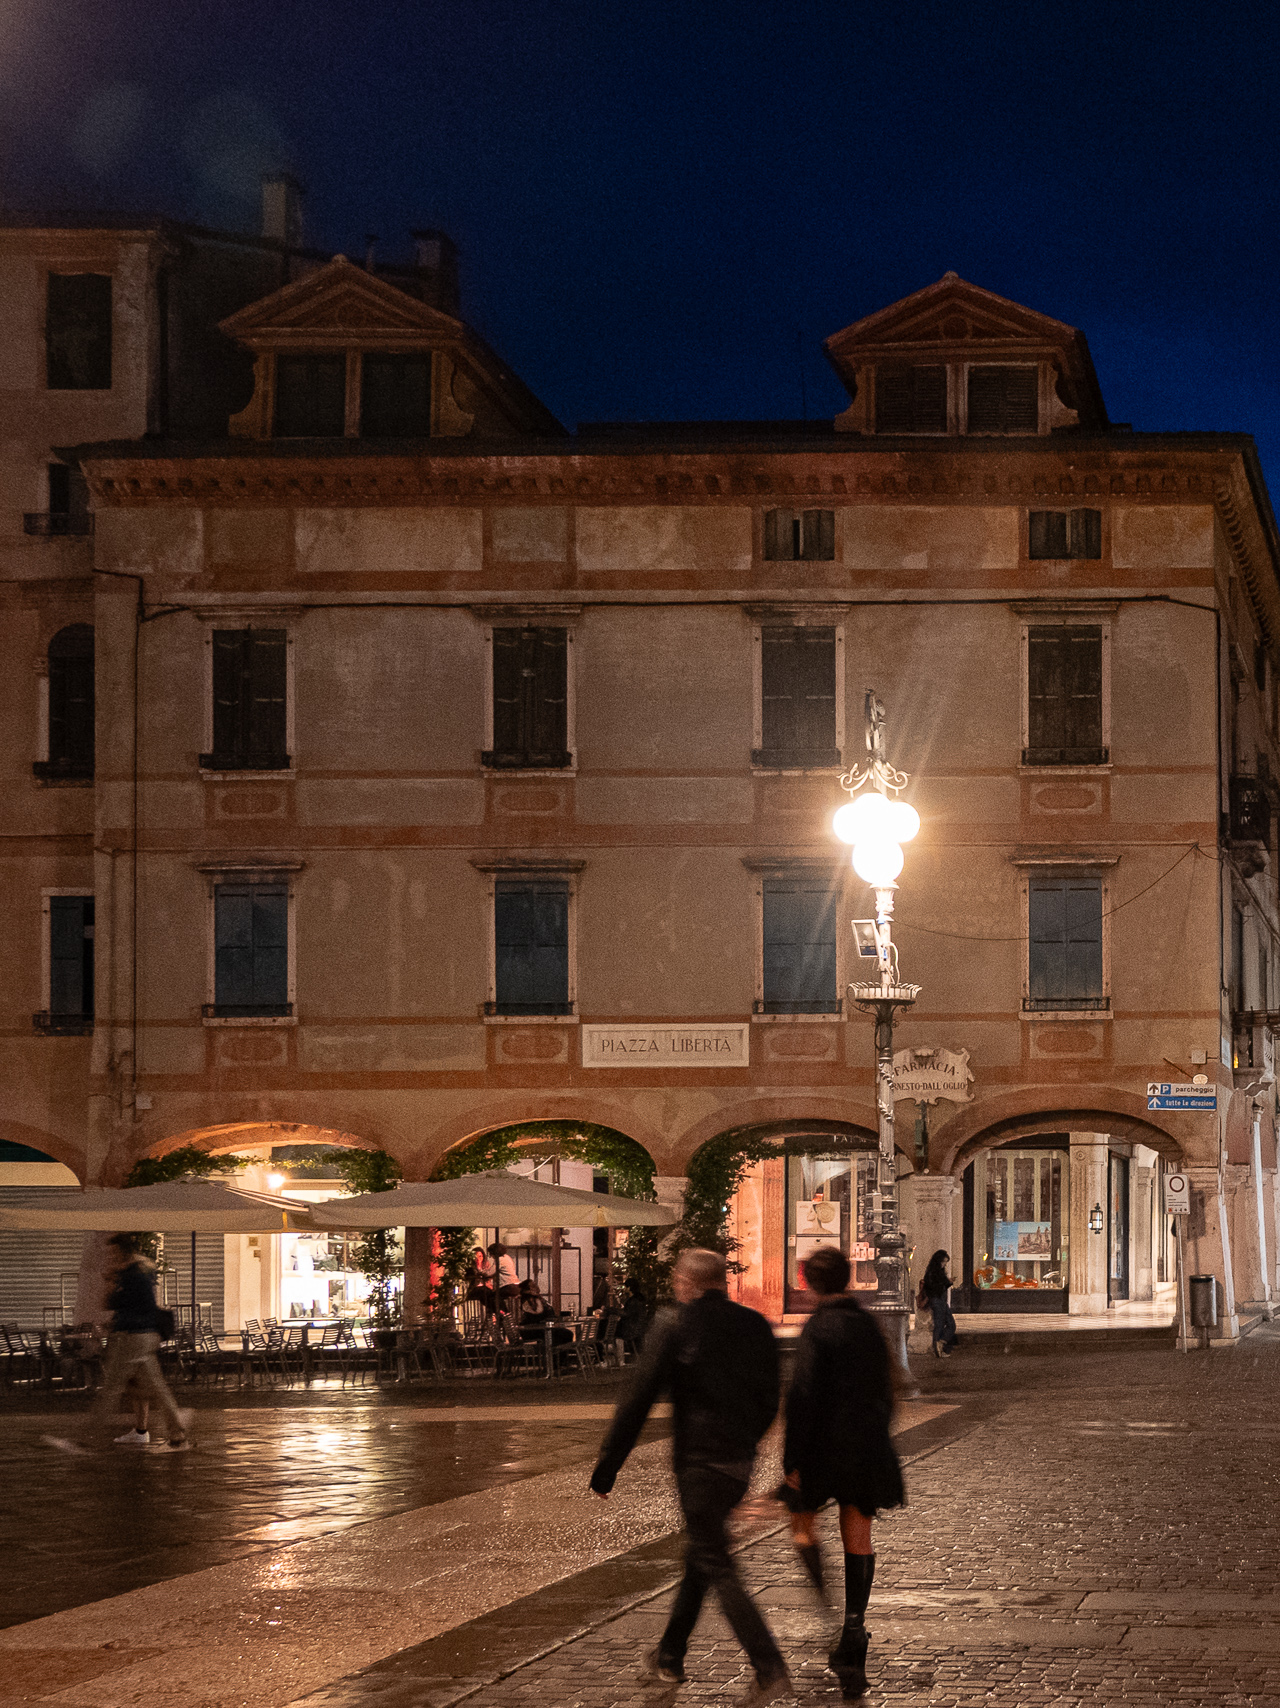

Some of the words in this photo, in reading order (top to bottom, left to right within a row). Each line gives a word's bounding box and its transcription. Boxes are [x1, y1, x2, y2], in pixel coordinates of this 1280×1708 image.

[602, 1038, 660, 1053] PIAZZA
[671, 1036, 732, 1053] LIBERTÀ
[1162, 1085, 1169, 1094] P
[1175, 1086, 1214, 1094] parcheggio
